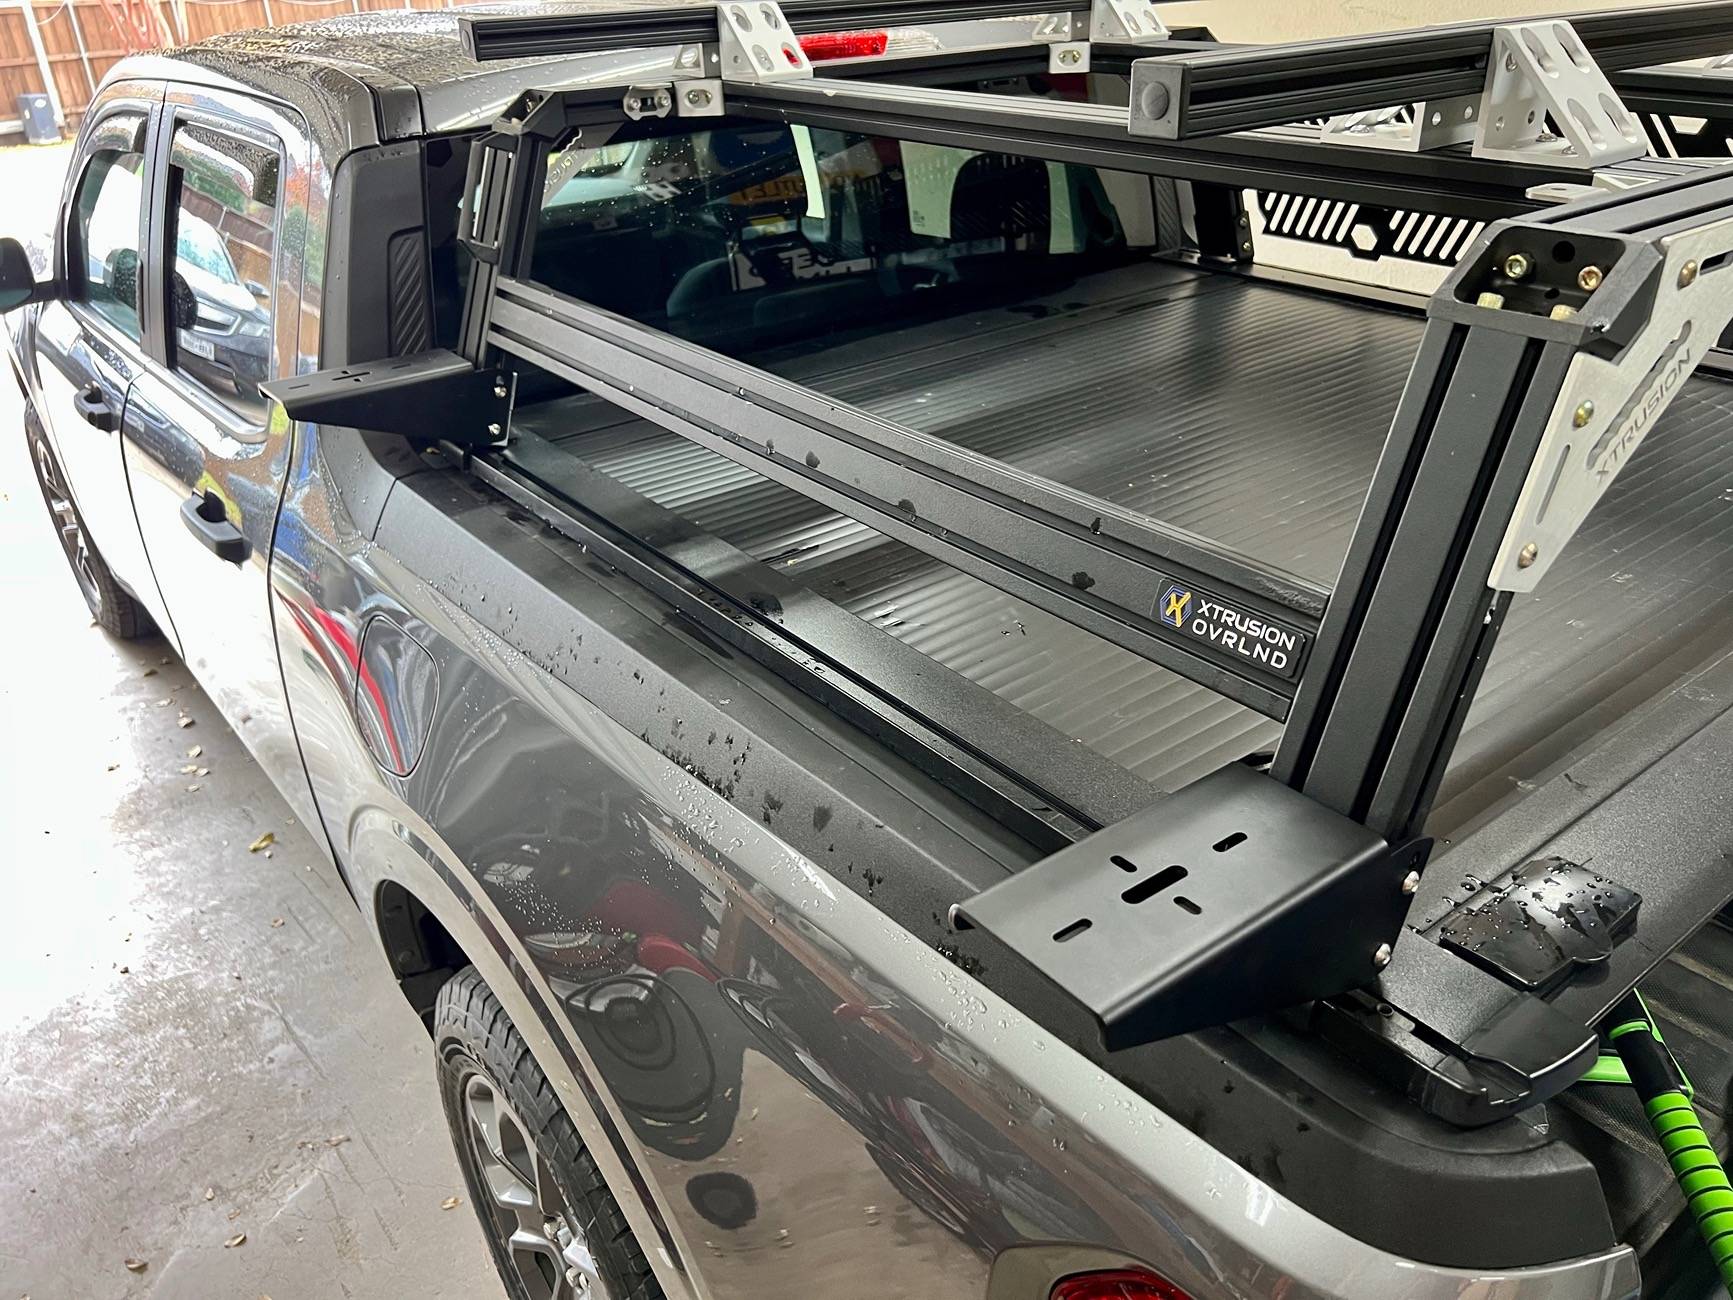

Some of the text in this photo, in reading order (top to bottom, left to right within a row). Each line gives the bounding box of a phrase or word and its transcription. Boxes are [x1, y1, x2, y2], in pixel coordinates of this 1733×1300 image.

[1596, 348, 1690, 484] XTRUSION
[1192, 618, 1288, 669] OVRLND
[1197, 599, 1296, 651] XTRUSION
